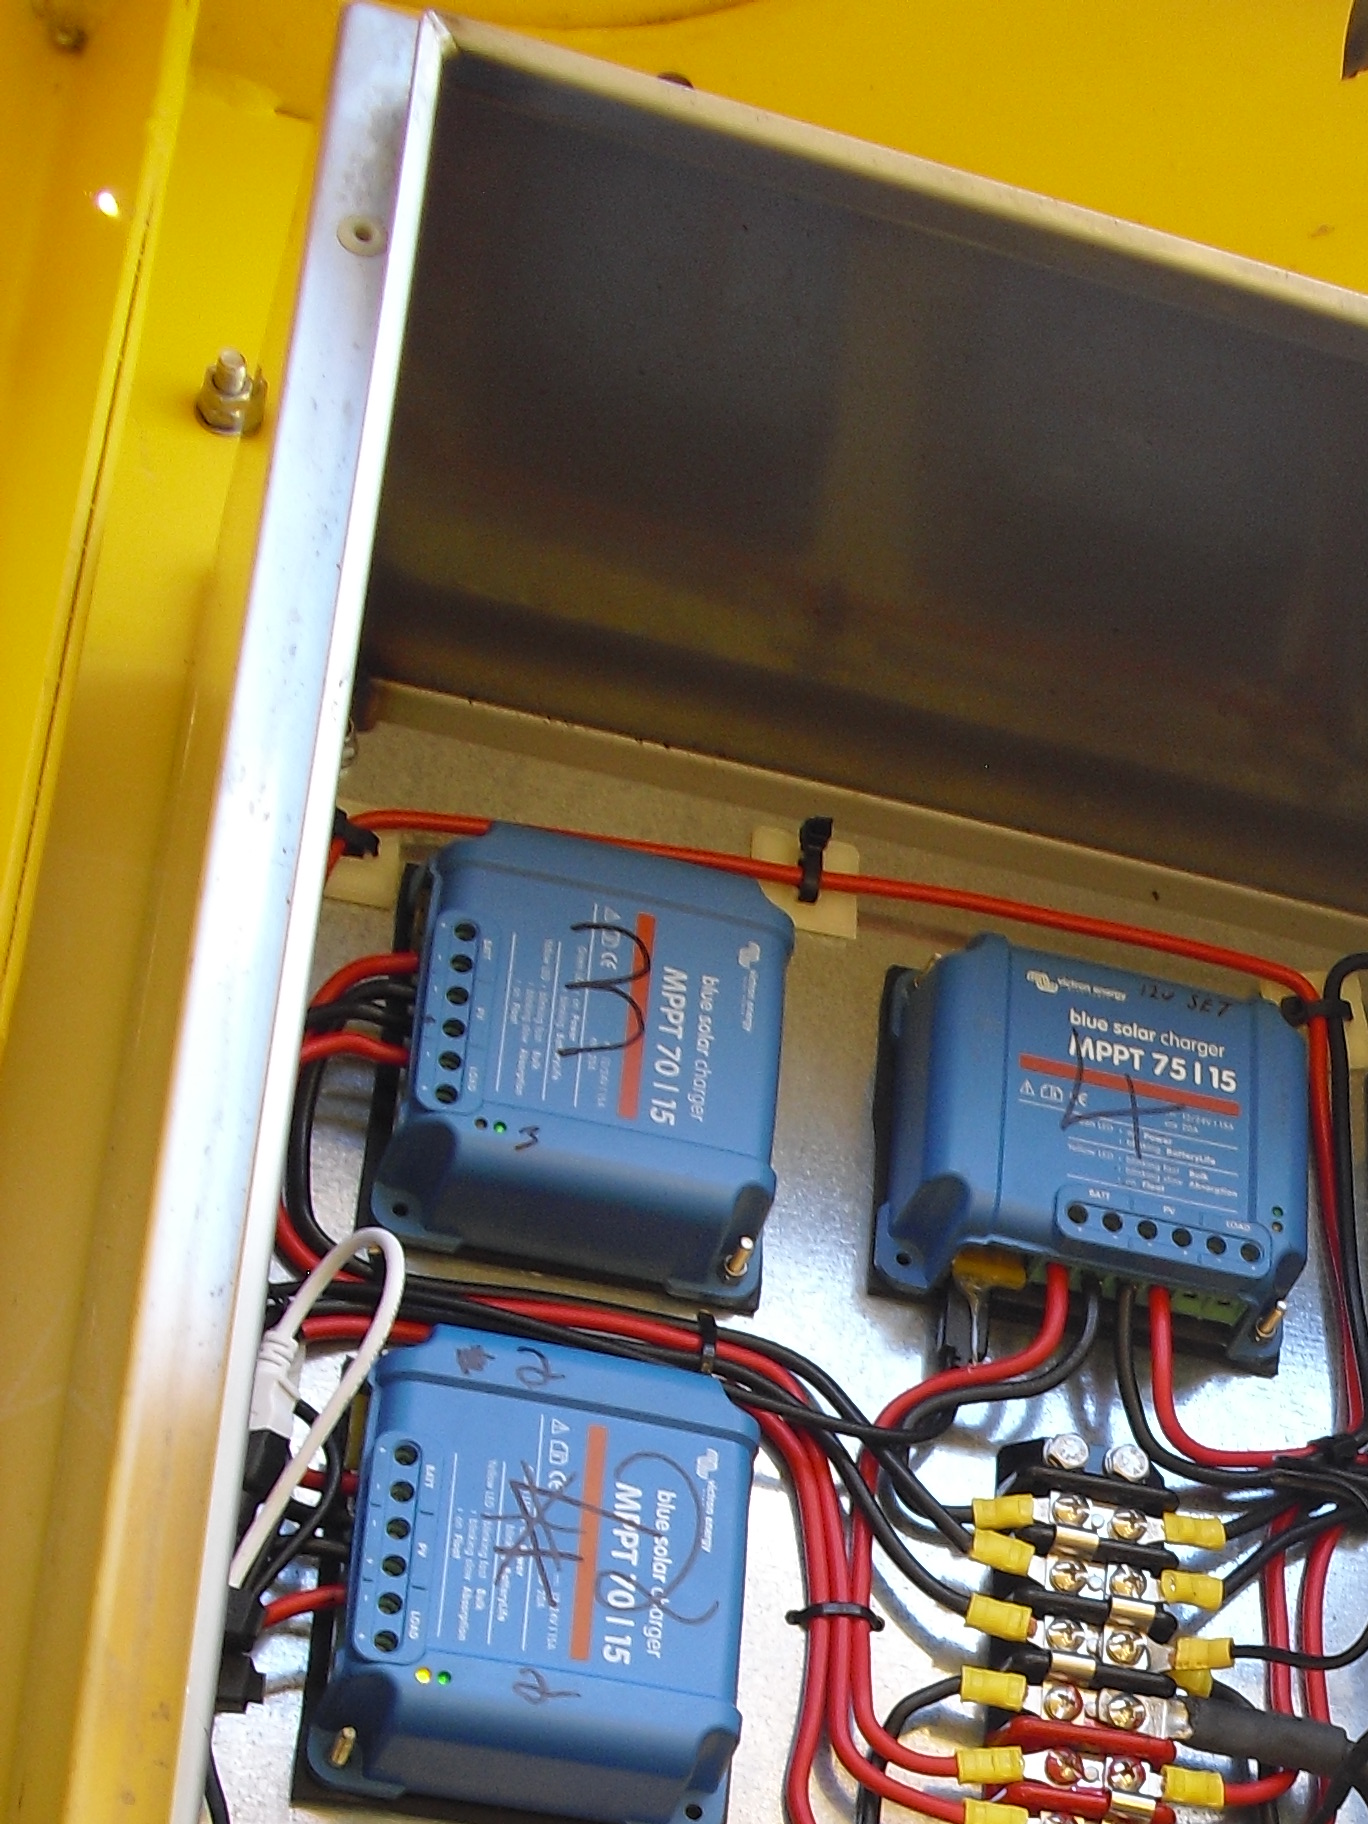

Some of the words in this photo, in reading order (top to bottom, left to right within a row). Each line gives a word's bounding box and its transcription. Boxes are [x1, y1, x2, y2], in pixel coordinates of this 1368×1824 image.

[658, 966, 688, 1039] MPPT
[699, 974, 719, 1012] blue
[1186, 993, 1232, 1019] SET
[696, 1014, 715, 1056] solar
[1069, 1007, 1108, 1032] blue
[1113, 1022, 1155, 1043] solar
[1160, 1030, 1225, 1059] charger
[654, 1043, 681, 1077] 70
[1068, 1033, 1144, 1071] MPPT
[1151, 1052, 1186, 1081] 75
[1208, 1066, 1237, 1093] 15
[649, 1098, 677, 1126] 15
[687, 1058, 711, 1123] charger
[610, 1481, 643, 1566] MPPT
[654, 1489, 676, 1532] blue
[651, 1536, 673, 1582] solar
[602, 1635, 632, 1665] 15
